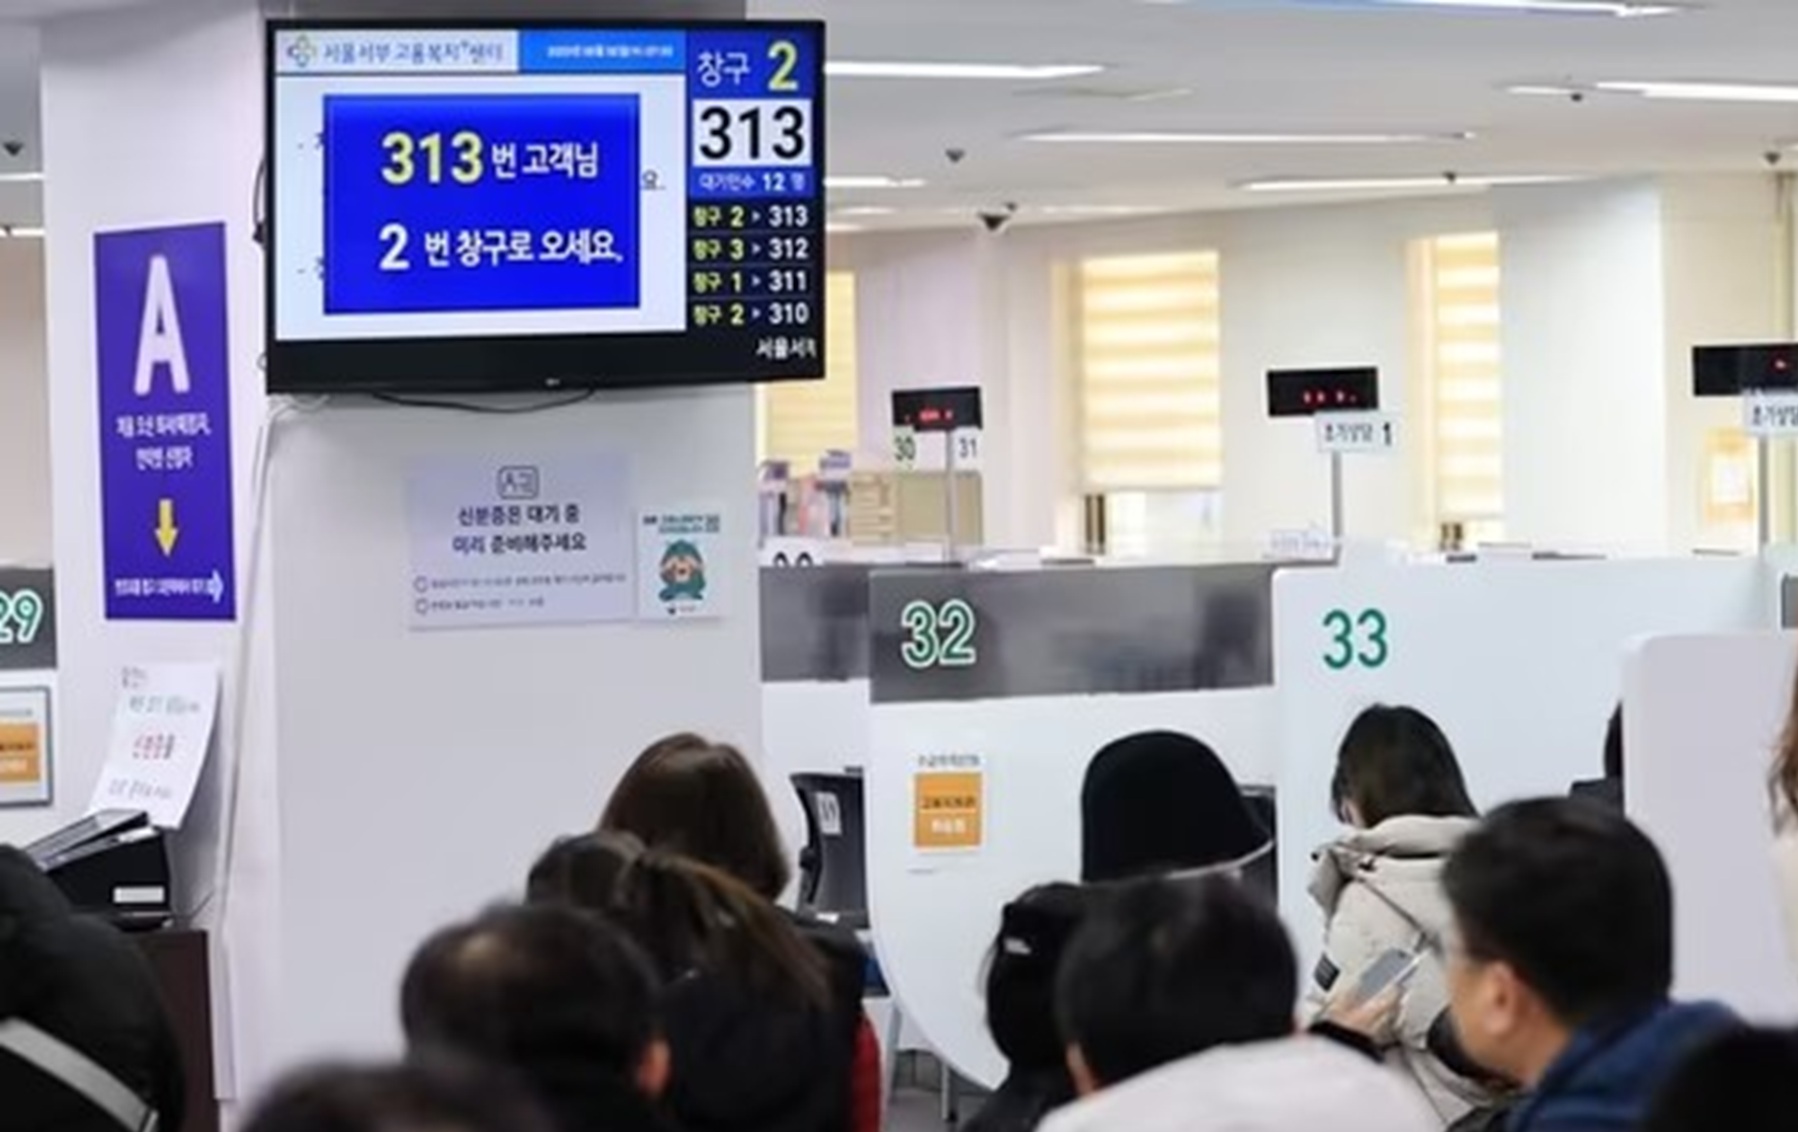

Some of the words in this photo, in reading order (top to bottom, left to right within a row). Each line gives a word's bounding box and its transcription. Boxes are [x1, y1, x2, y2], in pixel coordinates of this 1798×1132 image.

[697, 50, 751, 86] 창구
[767, 41, 799, 92] 2
[699, 105, 804, 161] 313
[380, 131, 484, 185] 313
[491, 145, 517, 179] 번
[523, 142, 599, 177] 고객님
[763, 172, 786, 192] 12
[730, 205, 745, 227] 2
[768, 204, 808, 226] 313
[378, 222, 410, 270] 2
[424, 230, 450, 264] 번
[457, 230, 534, 264] 창구로
[730, 238, 745, 260] 3
[768, 237, 808, 259] 312
[731, 271, 742, 293] 1
[768, 270, 808, 292] 311
[132, 254, 191, 396] A
[730, 304, 745, 326] 2
[768, 303, 808, 325] 310
[958, 437, 978, 459] 31
[459, 504, 521, 527] 신분증은
[526, 504, 560, 524] 대기
[452, 535, 486, 555] 미리
[490, 532, 587, 555] 준비해주세요
[901, 598, 976, 667] 32
[1322, 608, 1390, 670] 33
